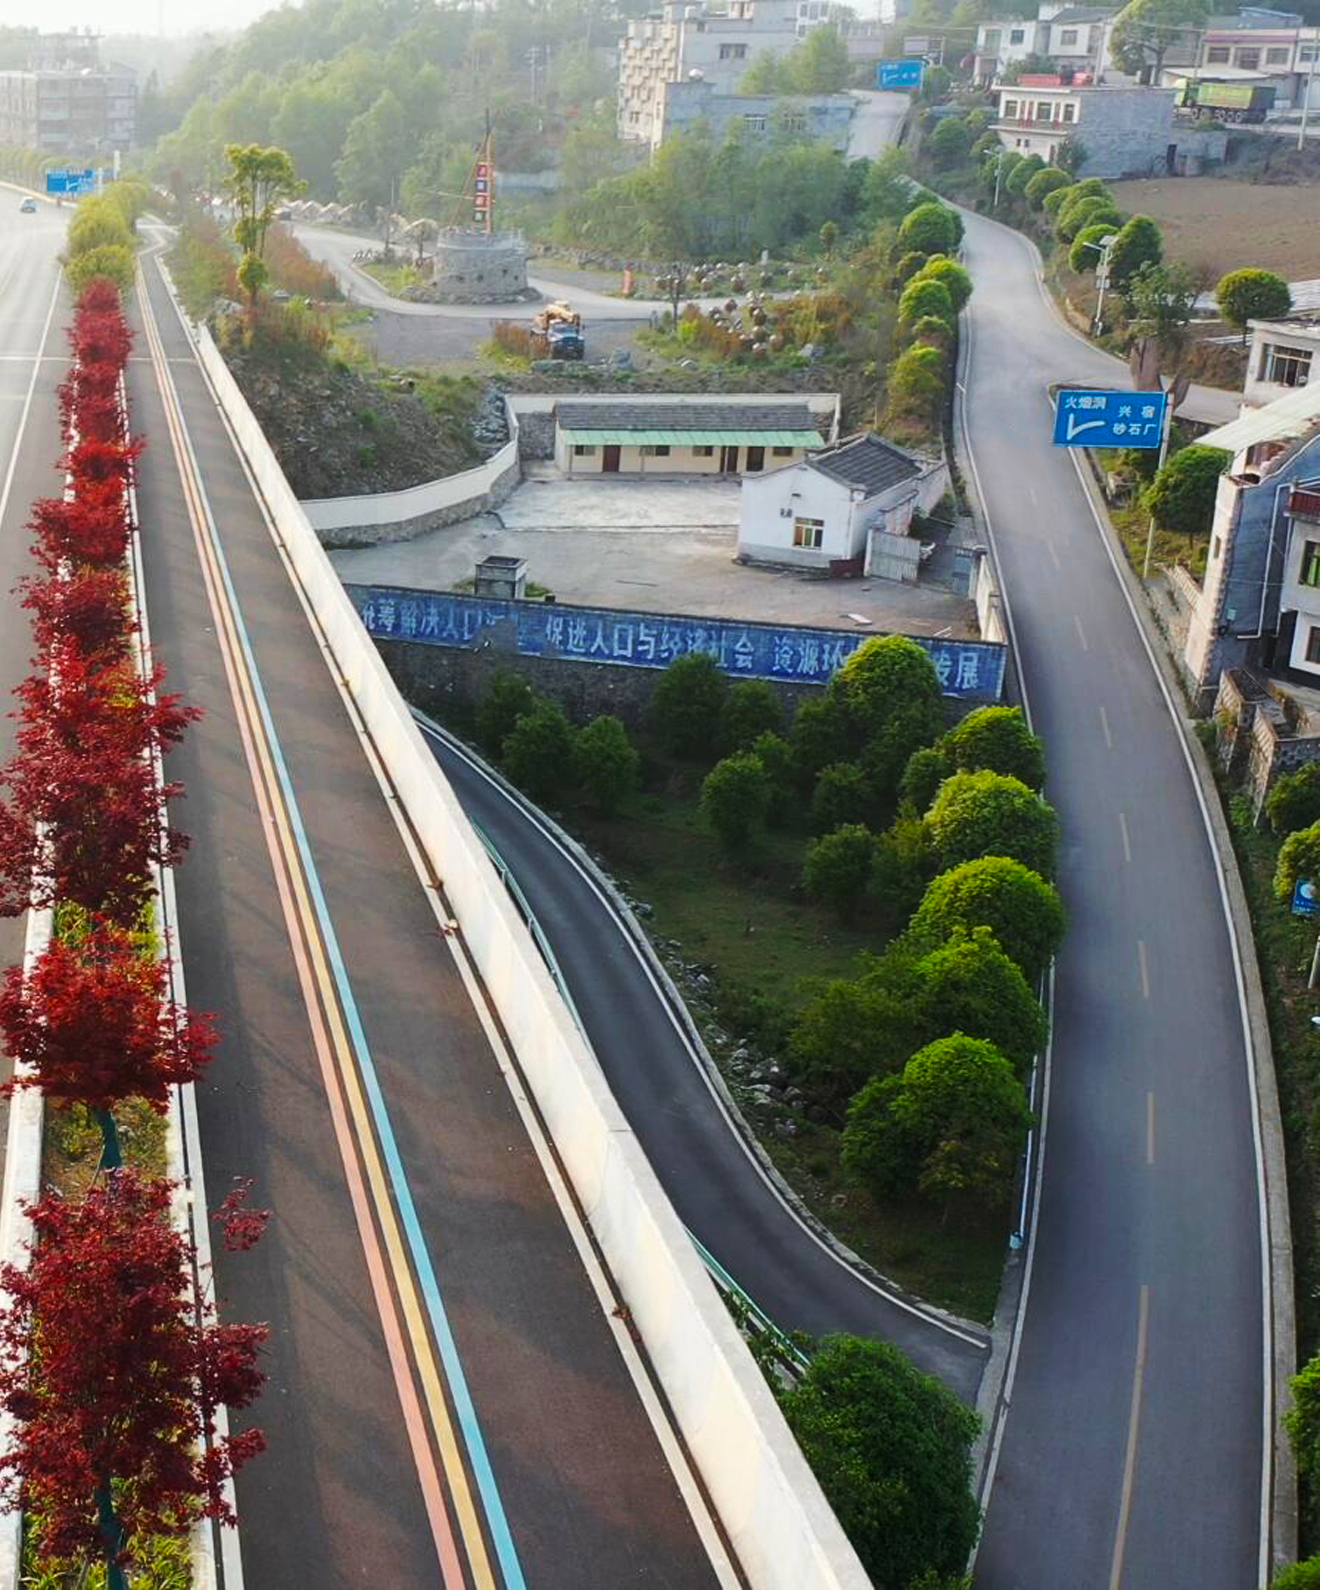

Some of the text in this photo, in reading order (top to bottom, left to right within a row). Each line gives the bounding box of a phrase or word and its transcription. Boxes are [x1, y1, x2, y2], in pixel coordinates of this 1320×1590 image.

[1064, 394, 1107, 410] 火烟洞
[1113, 422, 1157, 436] 砂石厂
